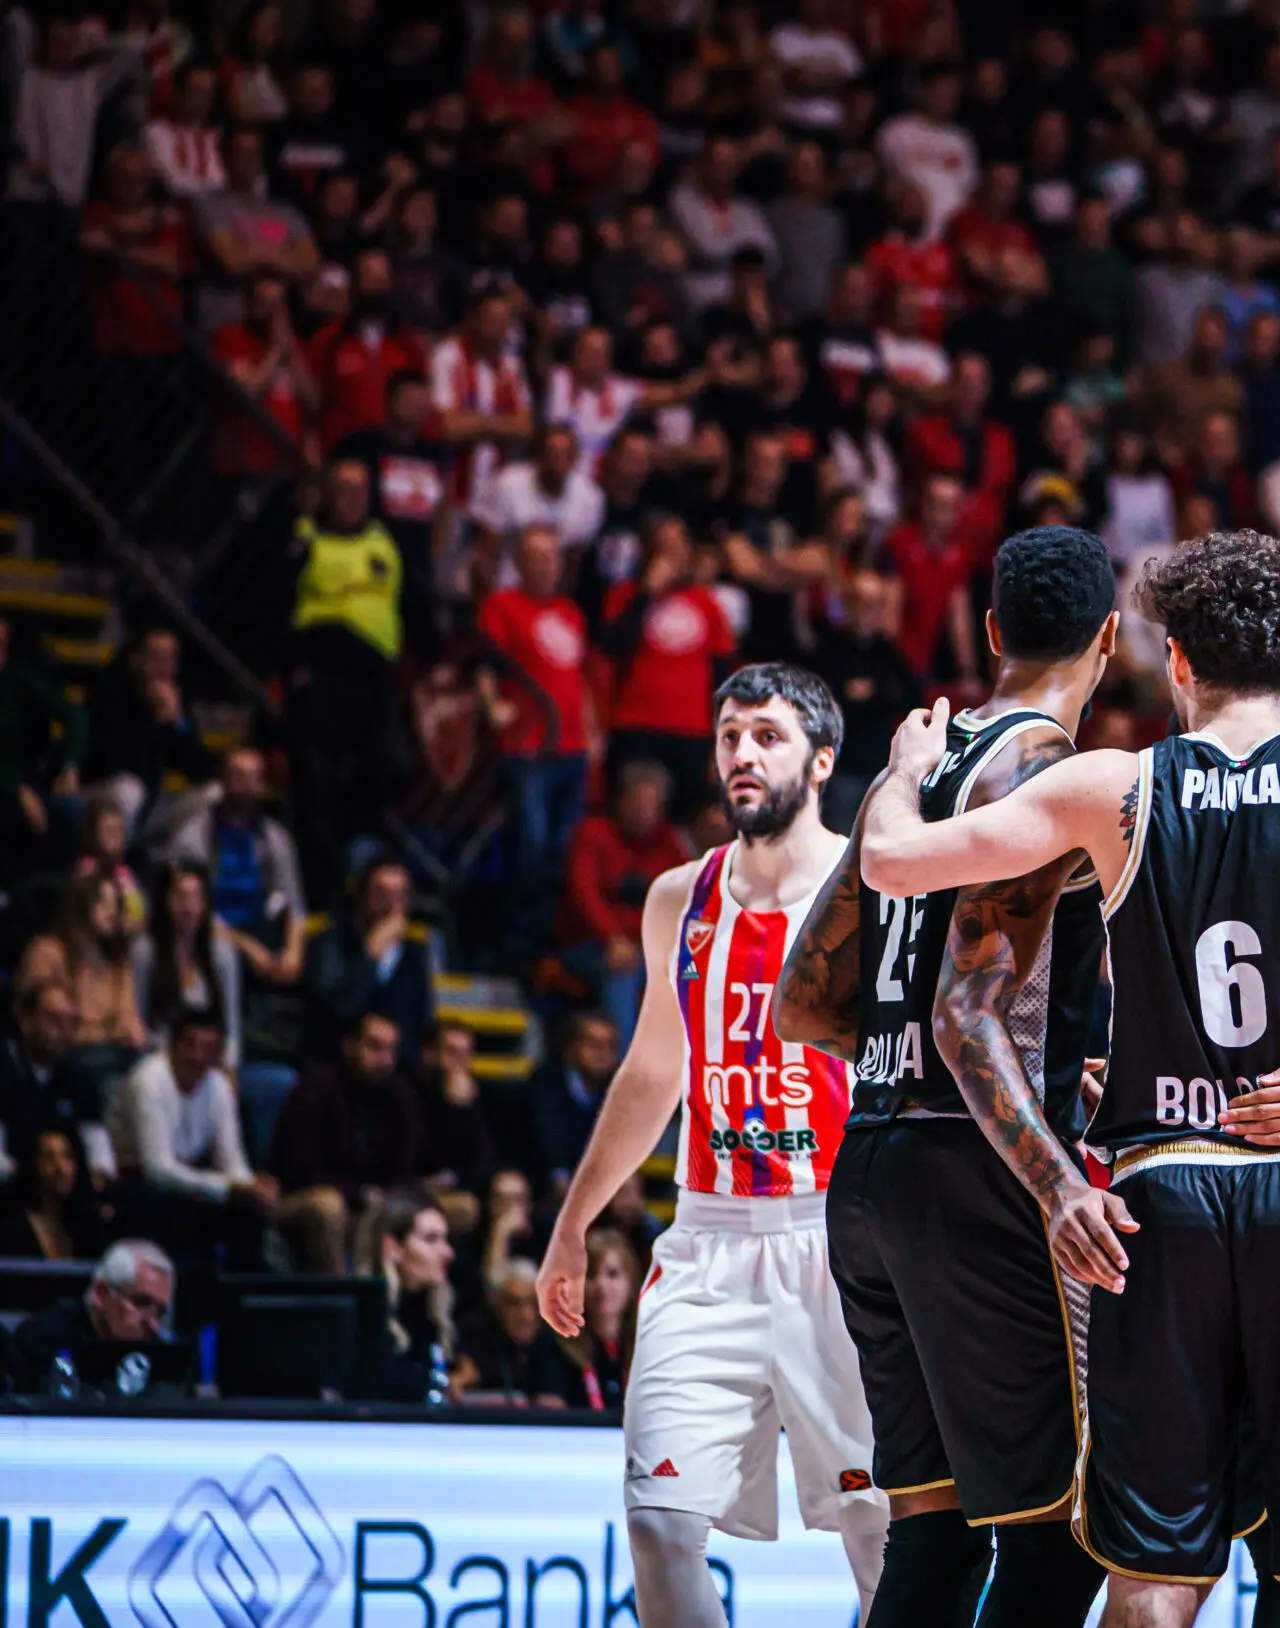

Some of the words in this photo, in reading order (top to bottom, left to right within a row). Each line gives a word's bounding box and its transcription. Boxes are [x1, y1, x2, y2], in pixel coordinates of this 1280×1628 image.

[728, 982, 774, 1042] 27
[1195, 920, 1268, 1048] 6
[703, 1055, 814, 1107] mts
